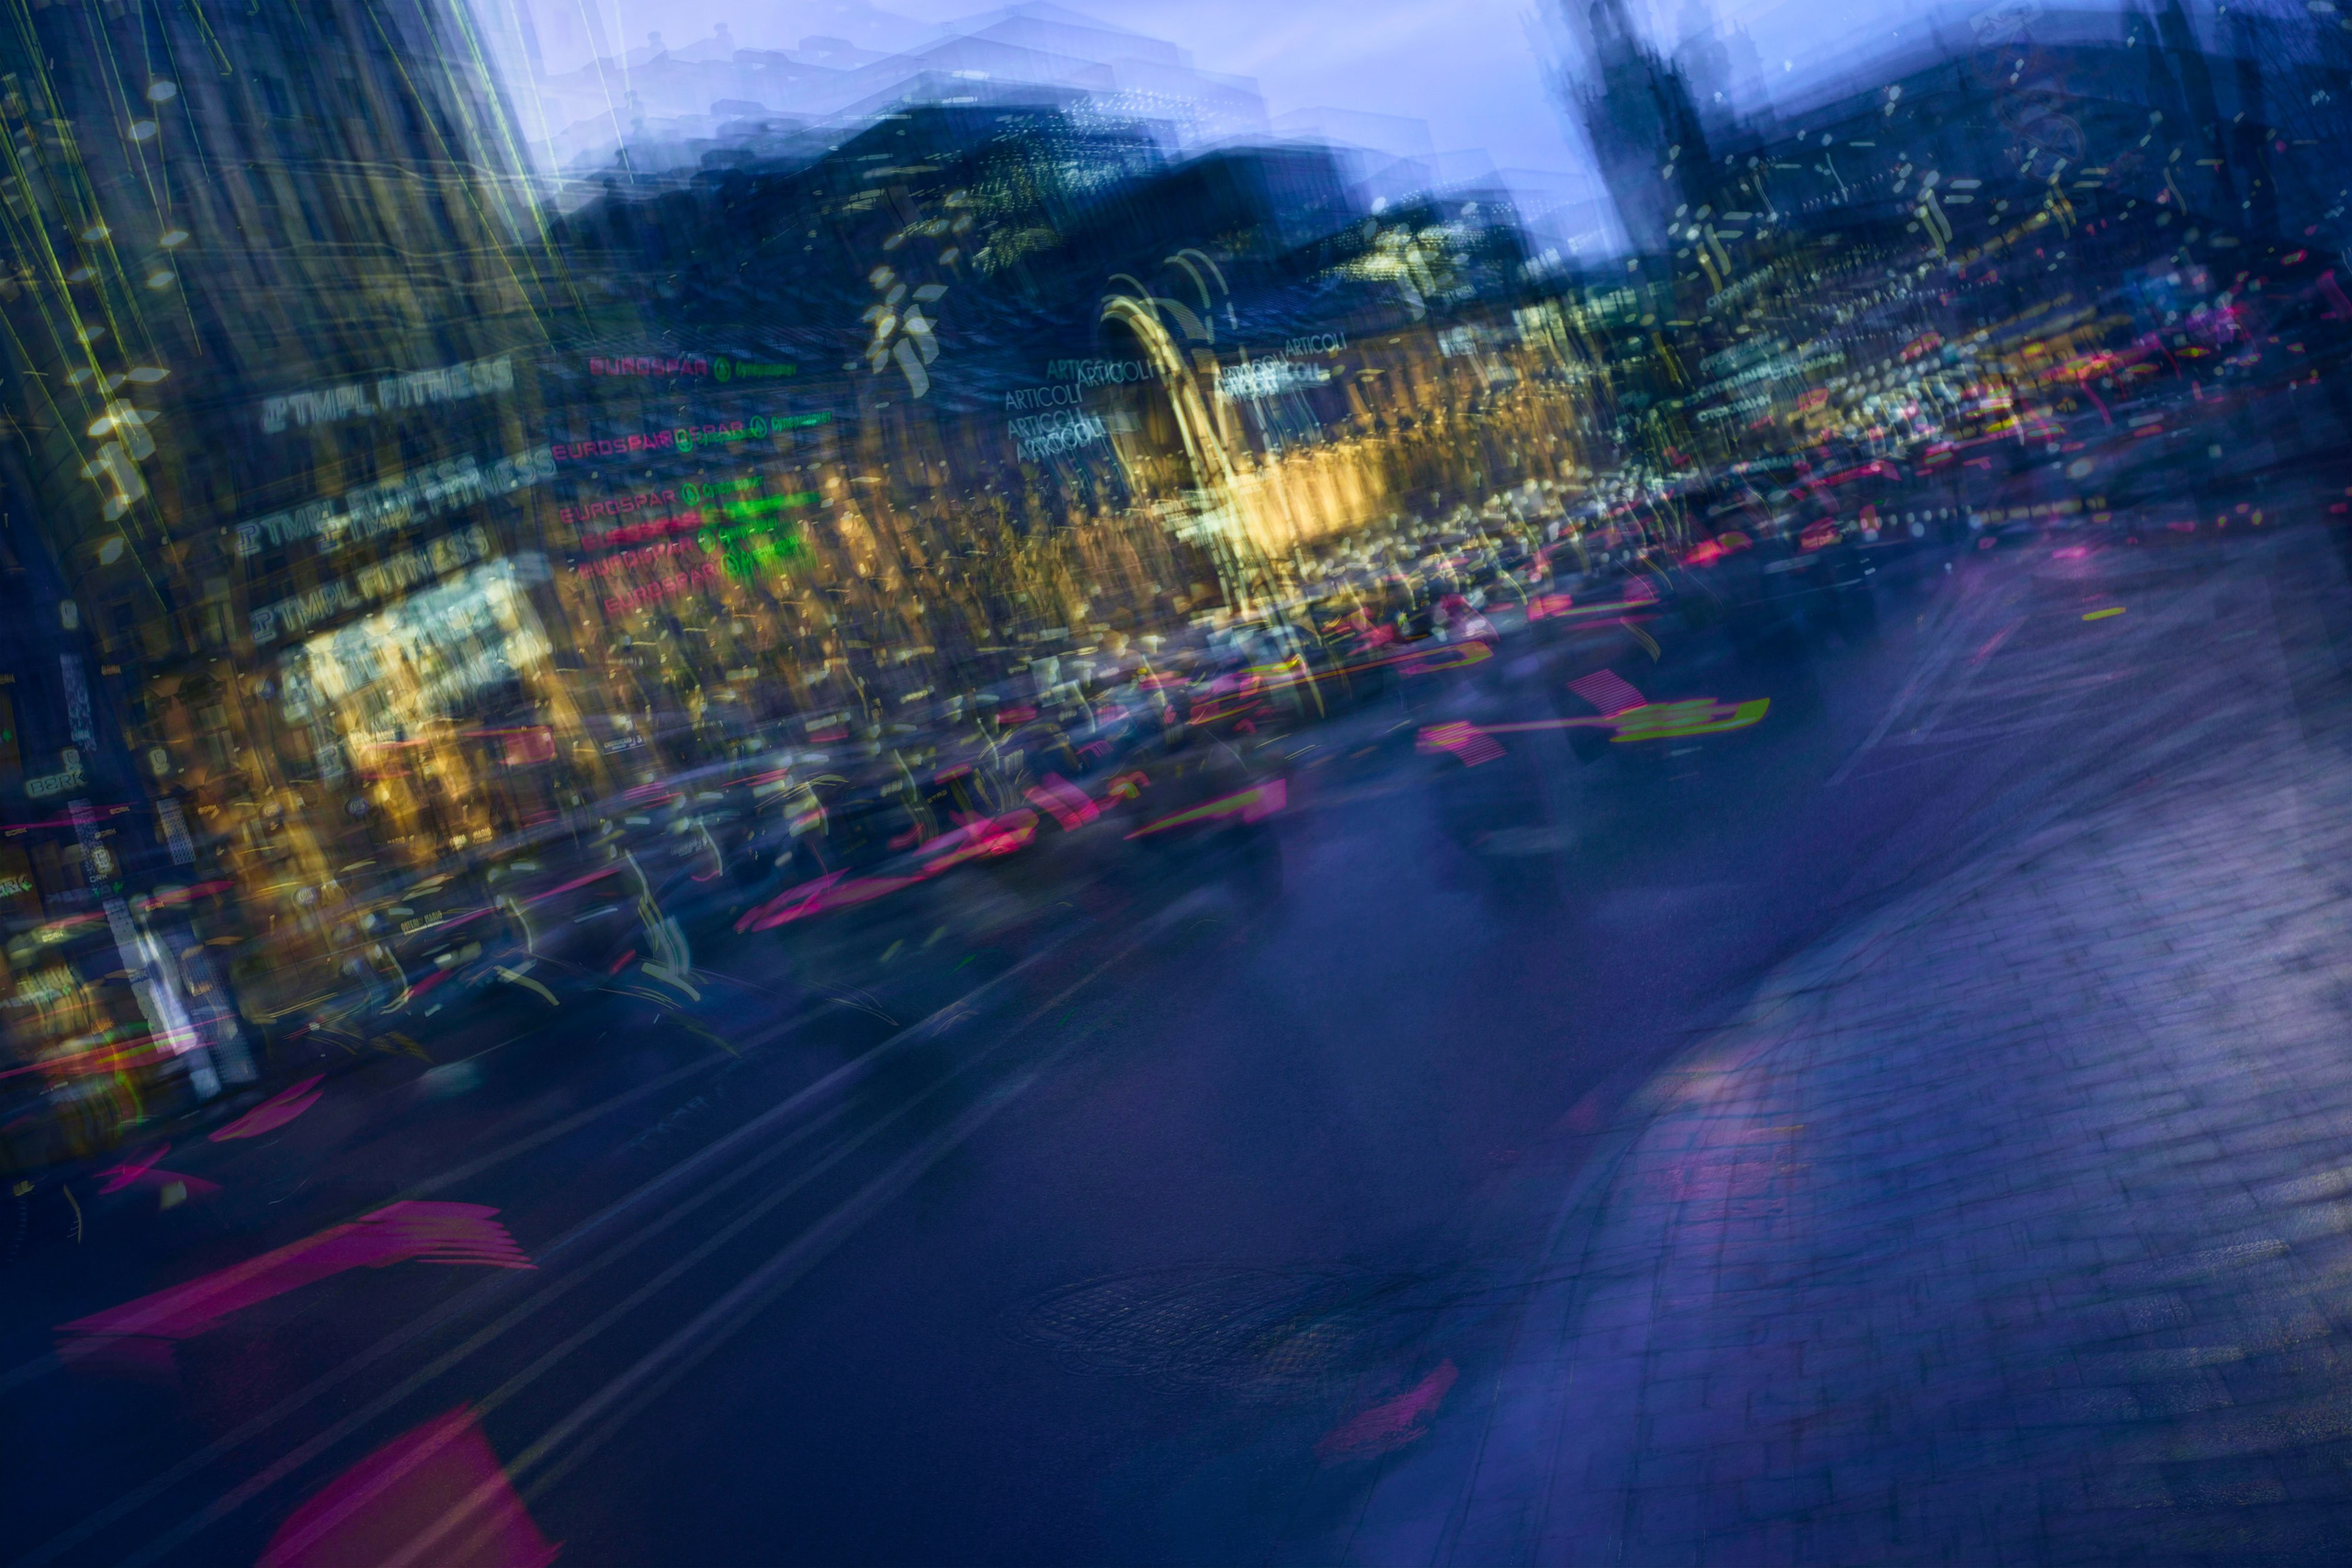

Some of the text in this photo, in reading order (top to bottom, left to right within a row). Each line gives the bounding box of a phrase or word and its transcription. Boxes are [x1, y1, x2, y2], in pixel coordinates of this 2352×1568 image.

[1286, 332, 1348, 356] ARTICOLI
[589, 355, 707, 377] EUROSPAR
[1005, 383, 1083, 411] ARTICOLI
[559, 490, 676, 525] EUROSPAR
[278, 525, 491, 631] TMPL FITNESS
[604, 562, 717, 615] EUROSPAR
